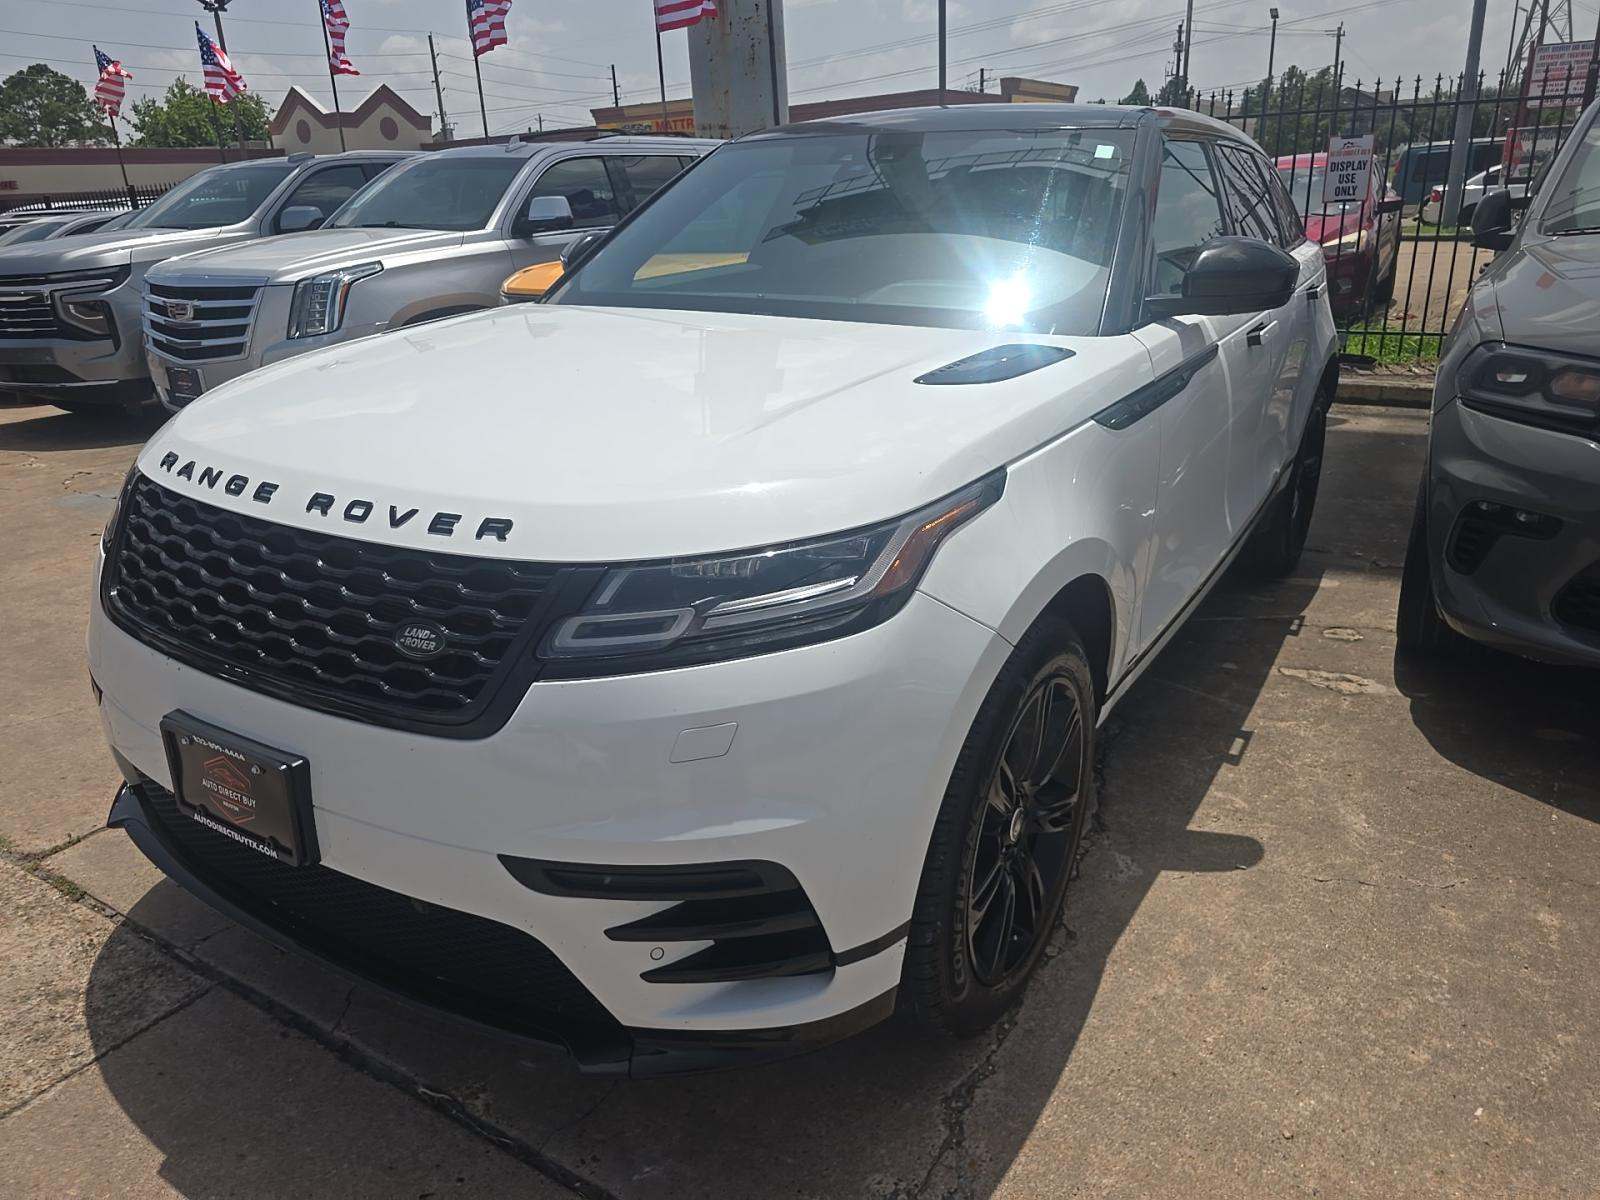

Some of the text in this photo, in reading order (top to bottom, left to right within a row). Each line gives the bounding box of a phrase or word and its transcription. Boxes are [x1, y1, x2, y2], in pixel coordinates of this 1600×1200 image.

[1329, 159, 1368, 173] DISPLAY
[1337, 172, 1357, 184] USE
[1334, 185, 1358, 197] ONLY
[159, 450, 514, 543] RANGE ROVER
[404, 627, 431, 639] LAND
[404, 637, 436, 651] ROVER
[202, 777, 256, 808] AUTO DIRECT BUY
[193, 813, 279, 860] AUTODIRECTBUYTX.COM
